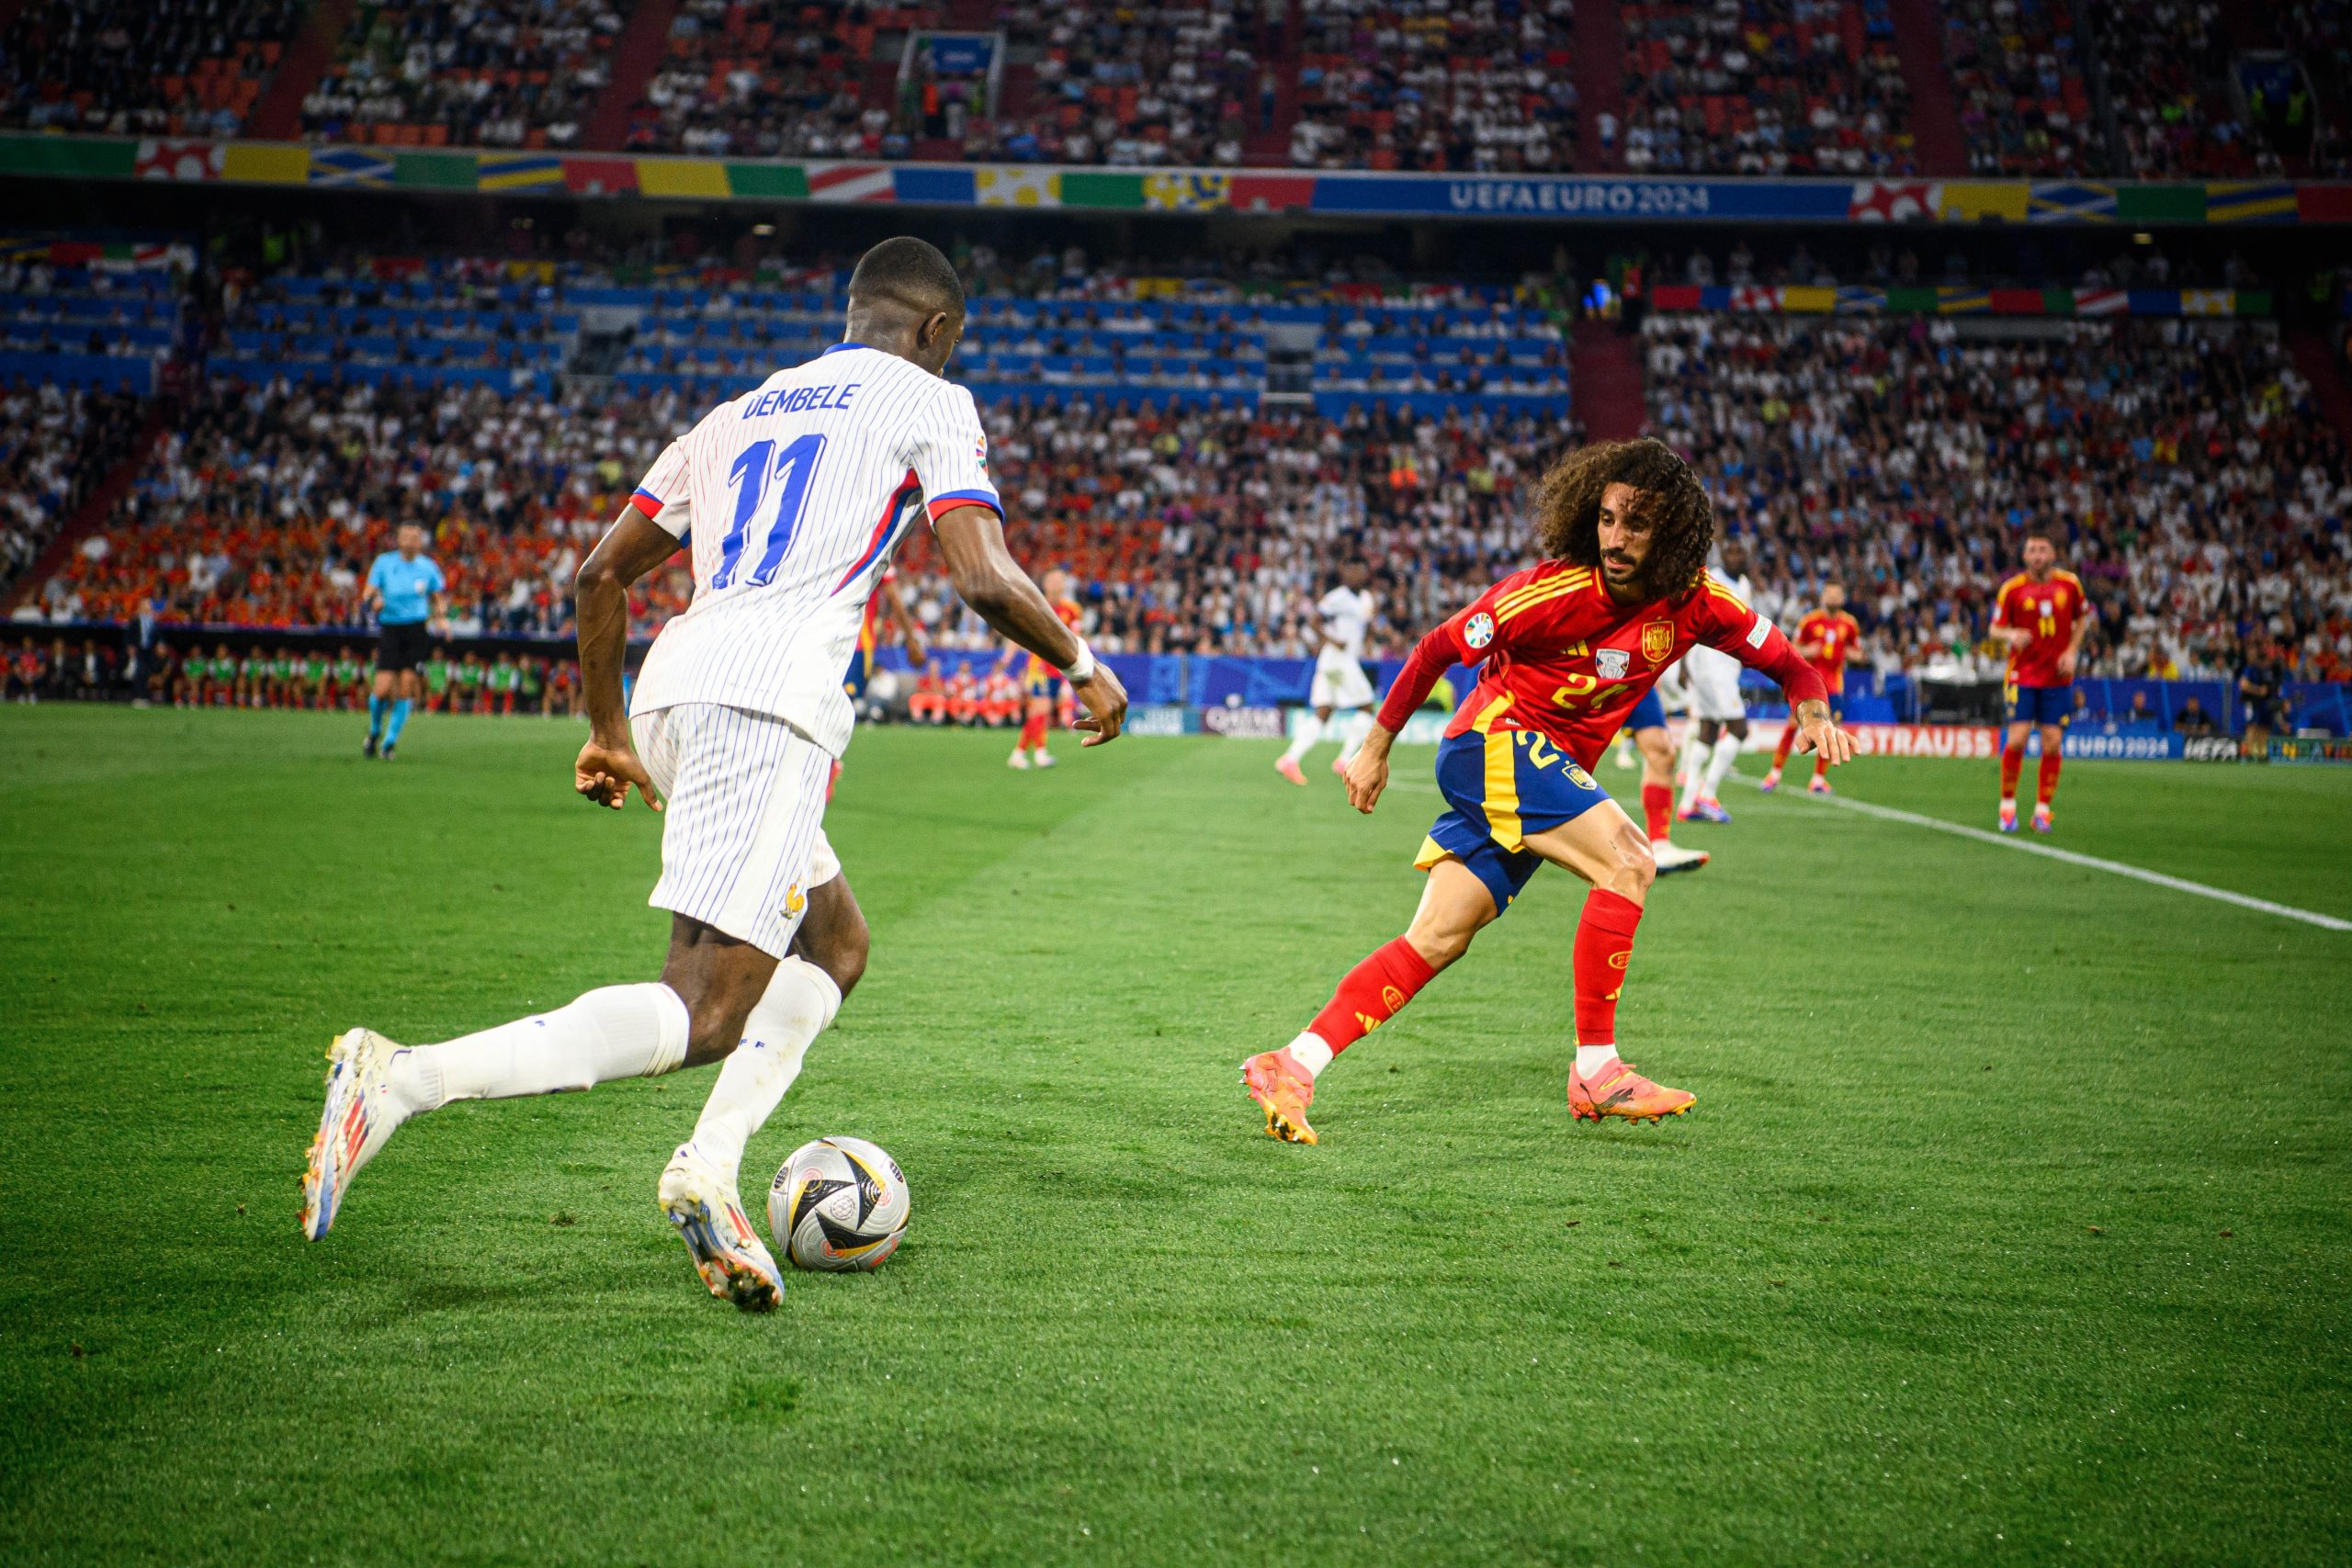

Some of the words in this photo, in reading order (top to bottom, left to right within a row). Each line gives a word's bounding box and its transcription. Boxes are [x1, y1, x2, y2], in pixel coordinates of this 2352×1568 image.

[1449, 183, 1535, 209] UEFA
[1537, 184, 1634, 210] EURO
[1636, 184, 1710, 212] 2024
[742, 384, 861, 419] DEMBELE
[713, 434, 827, 589] 11
[1516, 739, 1564, 770] 2
[1858, 725, 1993, 758] STRAUSS
